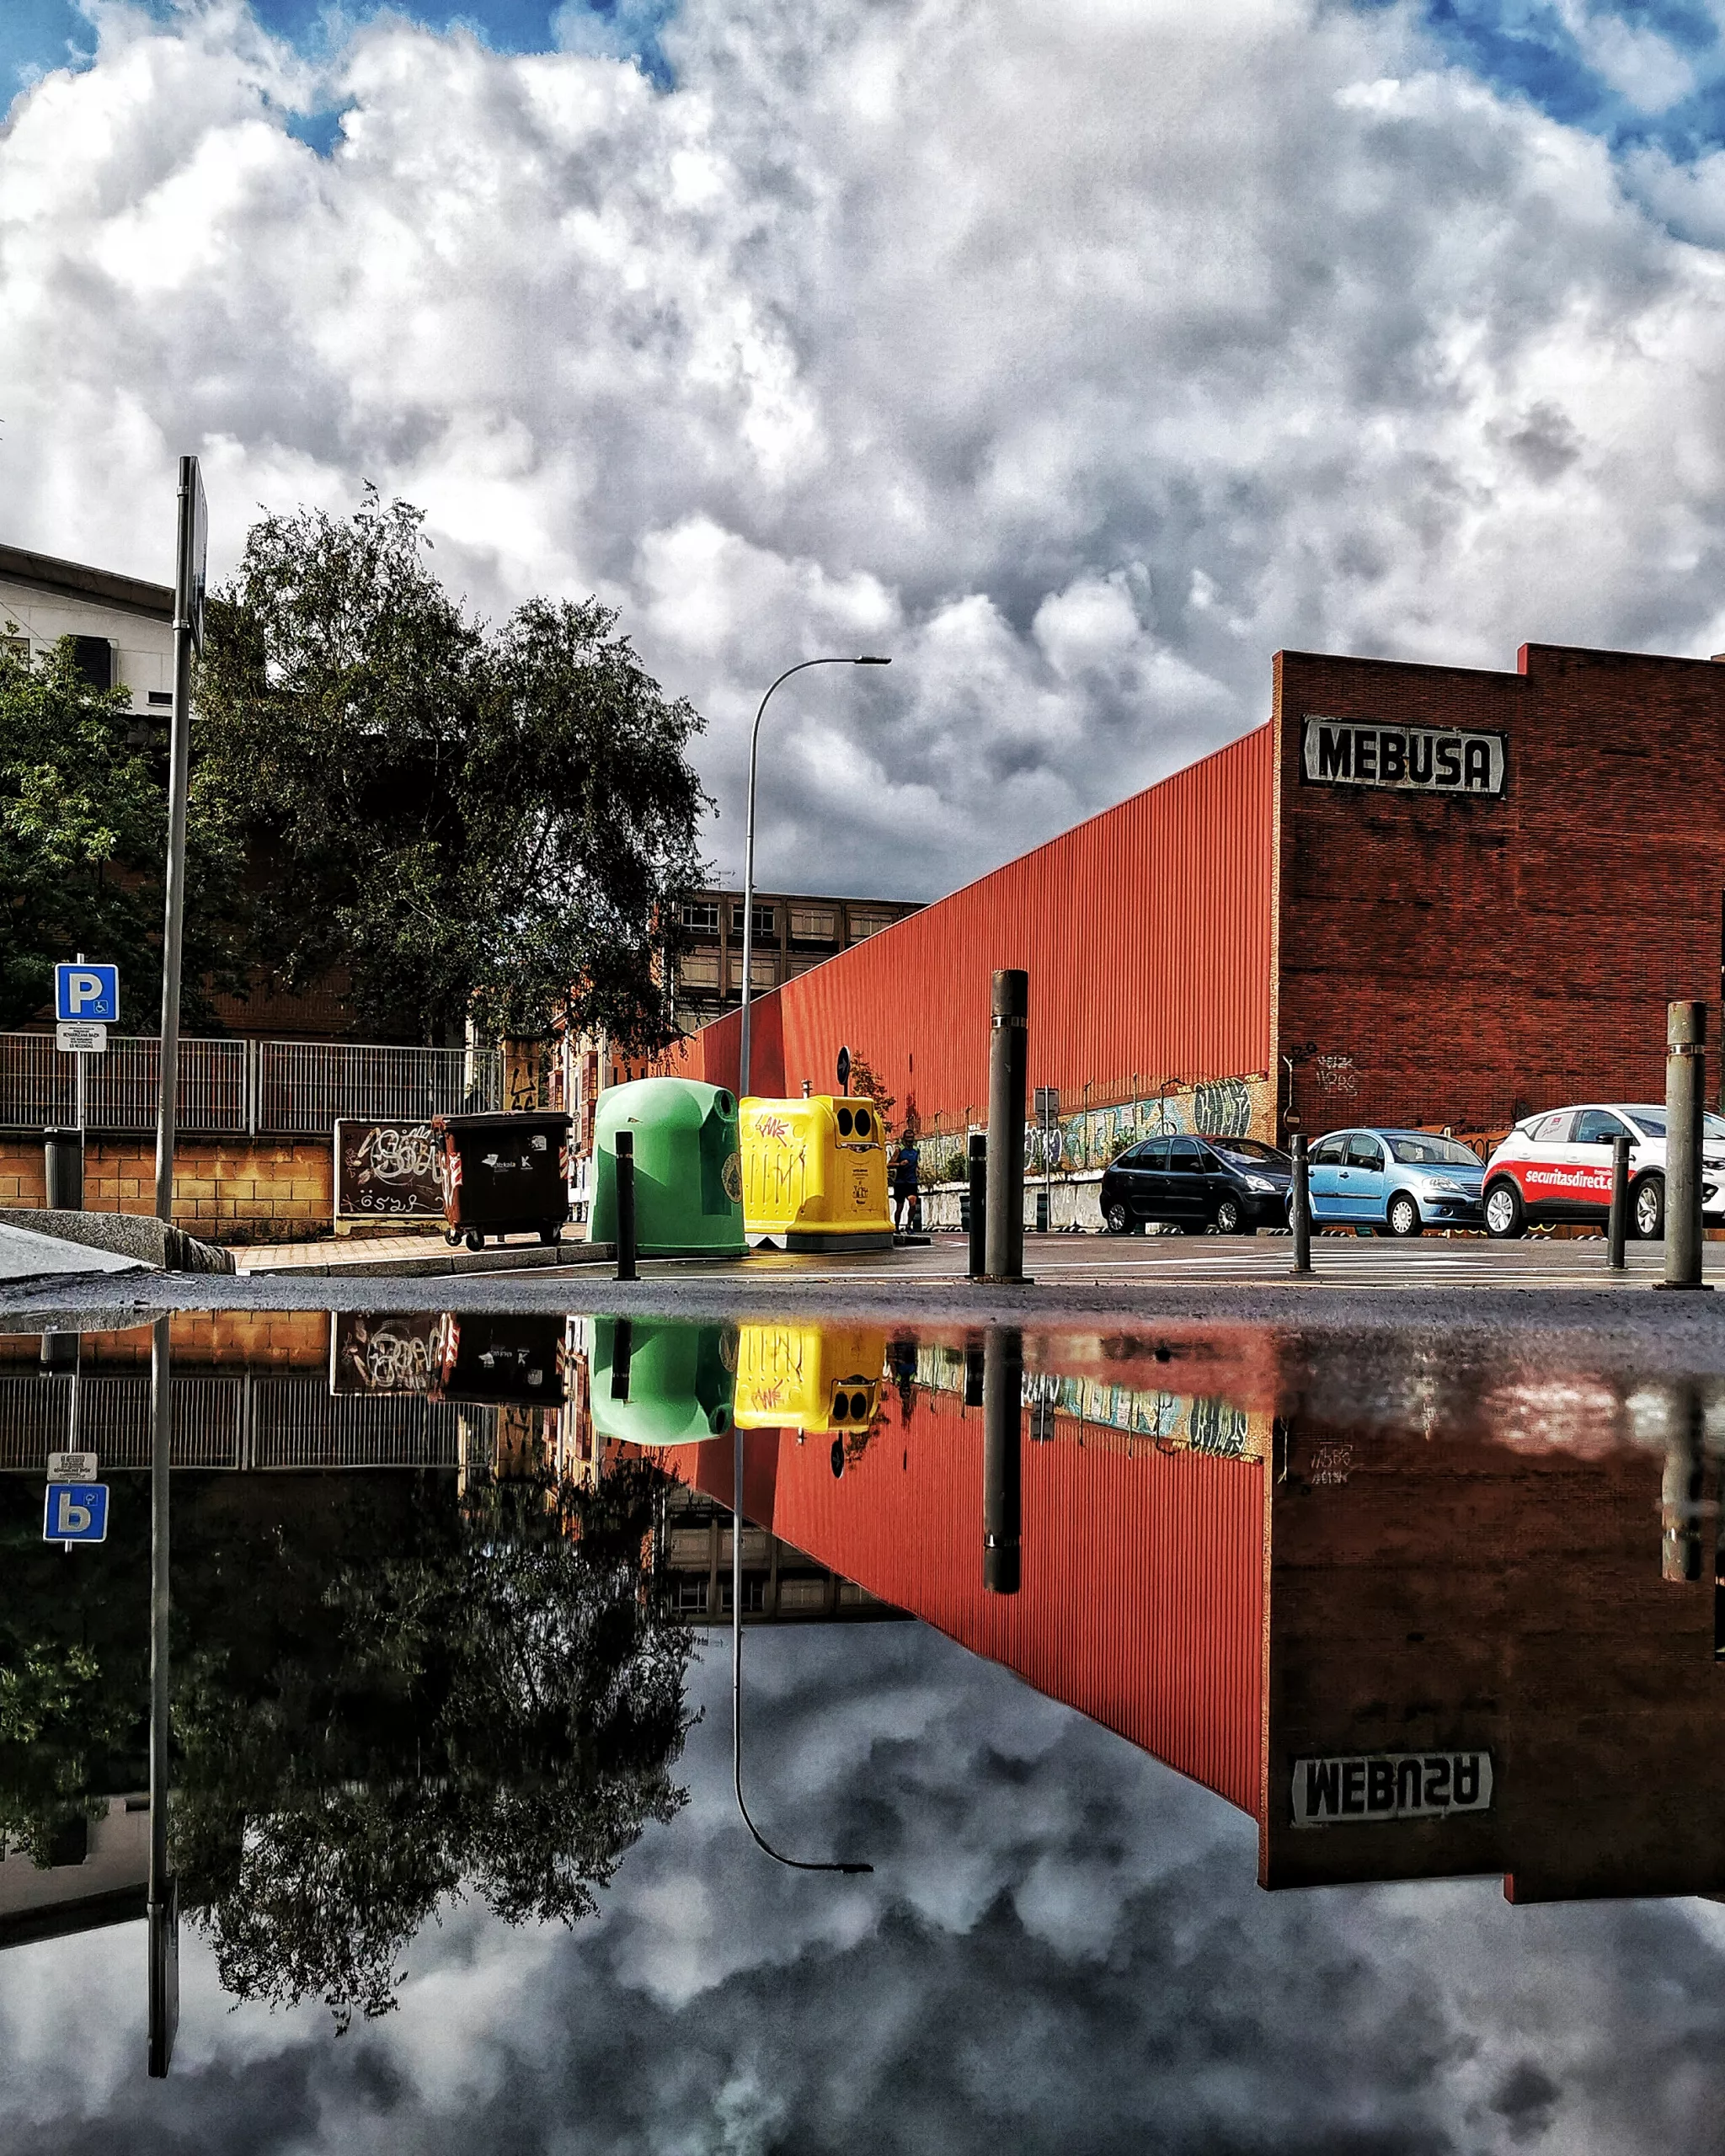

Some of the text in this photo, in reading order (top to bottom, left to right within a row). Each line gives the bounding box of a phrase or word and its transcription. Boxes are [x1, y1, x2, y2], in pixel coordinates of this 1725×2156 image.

[1318, 726, 1491, 790] MEBUSA
[69, 973, 103, 1013] P
[1525, 1168, 1613, 1190] securitasdirect.e
